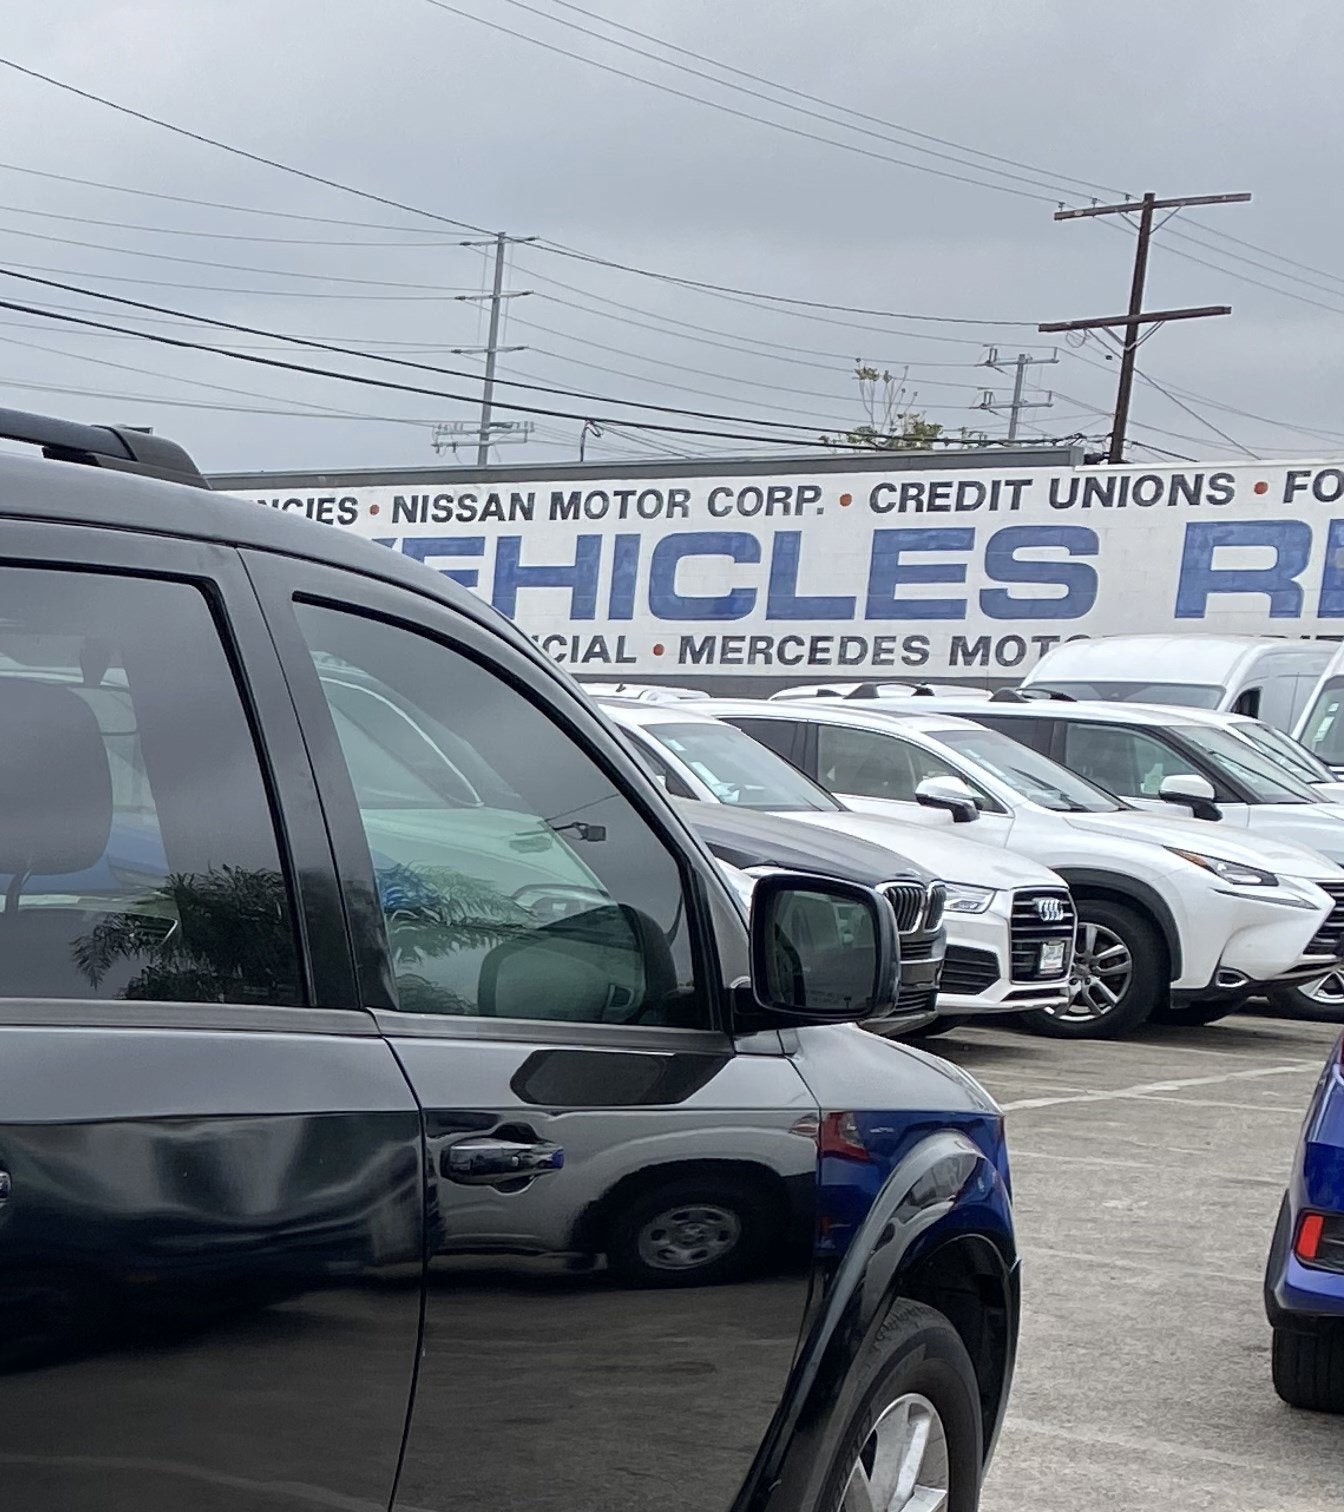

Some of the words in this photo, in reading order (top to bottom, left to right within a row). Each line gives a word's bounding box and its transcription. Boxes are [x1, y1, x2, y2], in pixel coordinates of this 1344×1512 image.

[392, 492, 536, 524] NISSAN
[549, 488, 692, 521] MOTOR
[708, 485, 824, 518] CORP.
[869, 478, 1033, 513] CREDIT
[1049, 472, 1236, 509] UNIONS
[372, 525, 1100, 620] EHICLES
[531, 634, 637, 664] CIAL
[678, 634, 930, 667] MERCEDES
[948, 634, 1092, 667] MOT
